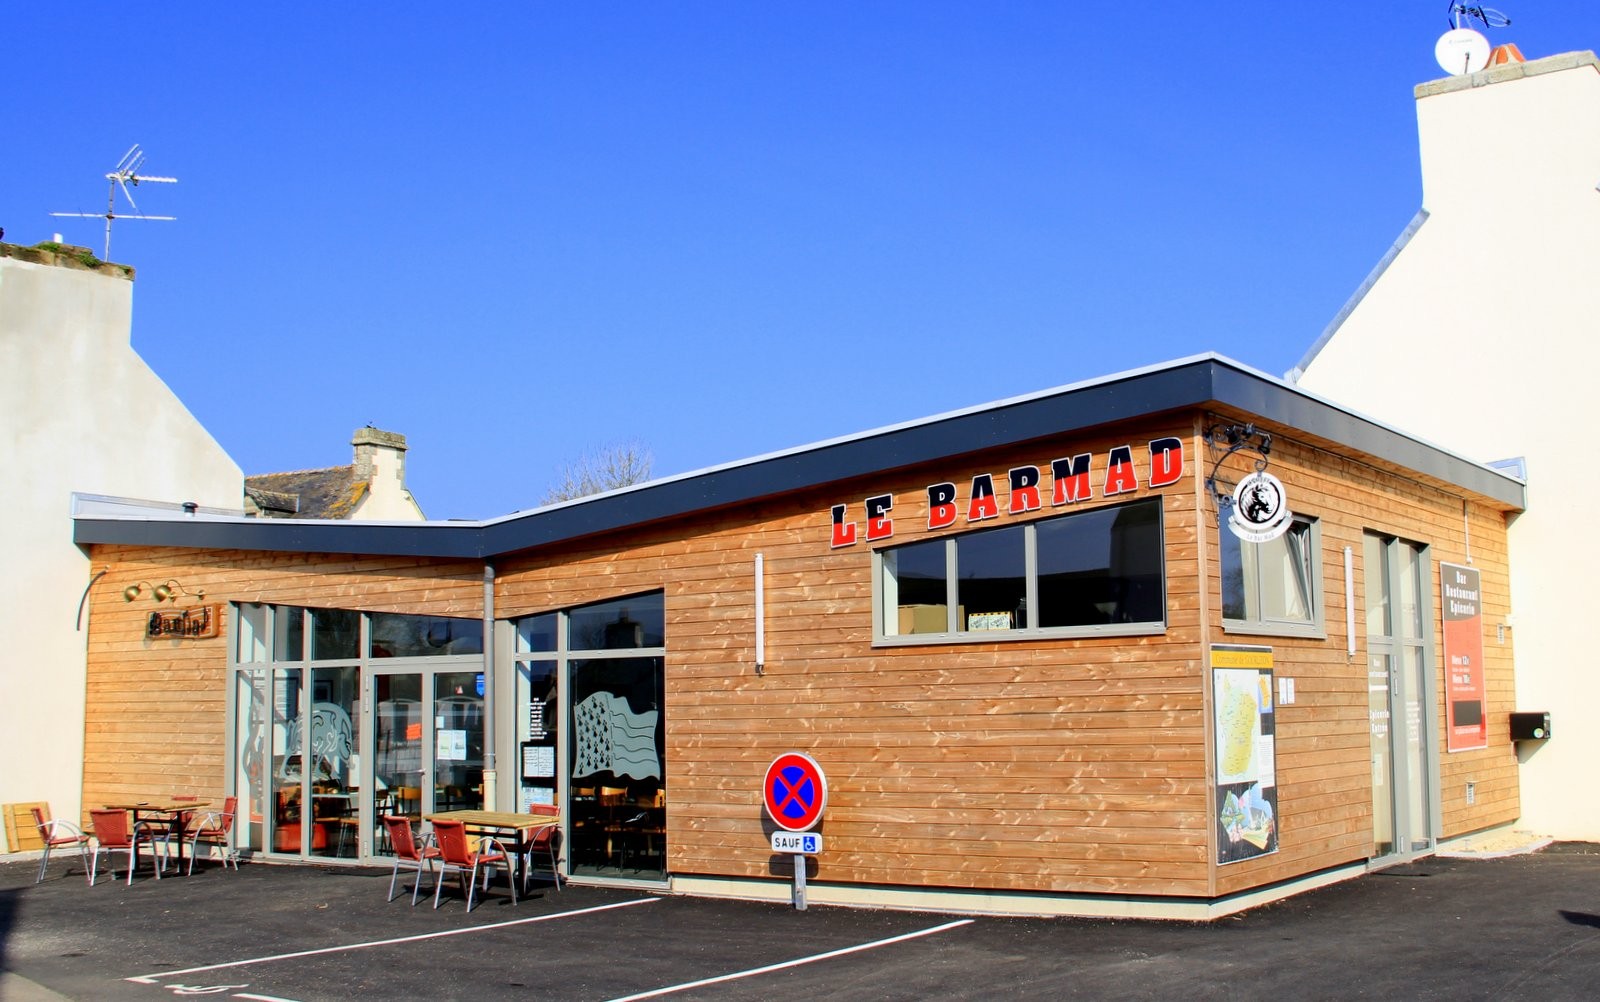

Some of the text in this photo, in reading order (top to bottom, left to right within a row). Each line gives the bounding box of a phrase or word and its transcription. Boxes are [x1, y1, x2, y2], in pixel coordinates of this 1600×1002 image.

[830, 436, 1184, 548] LE BARMAD
[1456, 570, 1467, 584] Bar
[1445, 583, 1478, 600] Restaurant
[774, 837, 801, 848] SAUF
